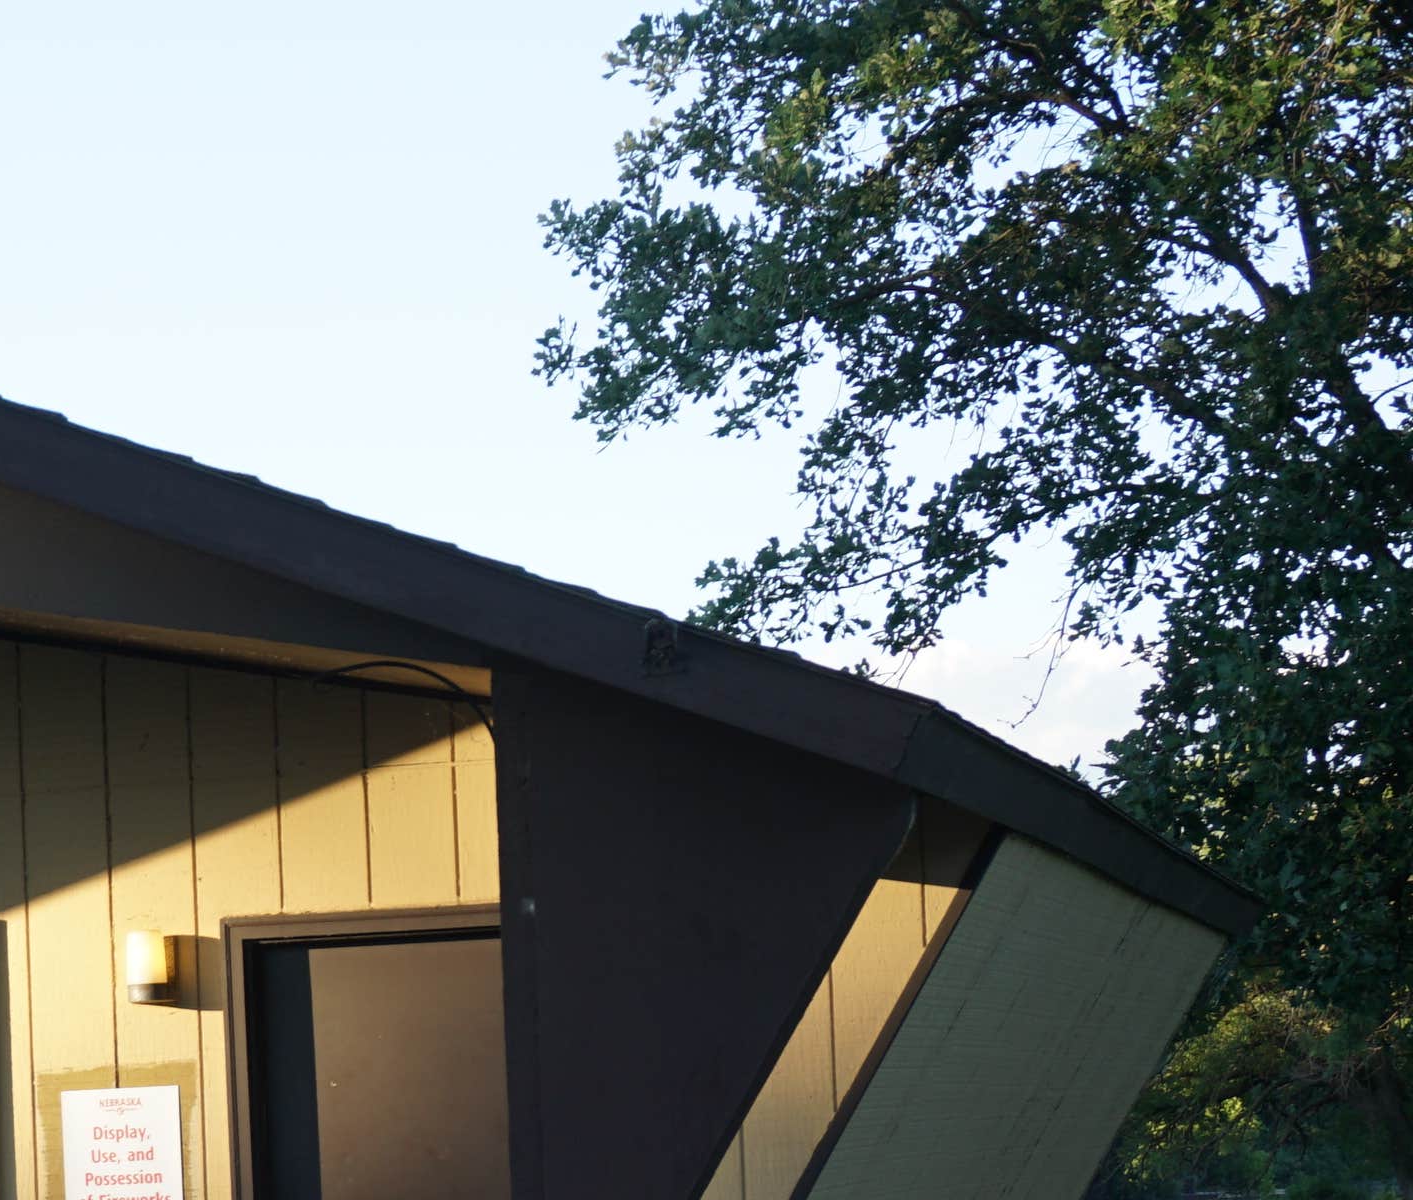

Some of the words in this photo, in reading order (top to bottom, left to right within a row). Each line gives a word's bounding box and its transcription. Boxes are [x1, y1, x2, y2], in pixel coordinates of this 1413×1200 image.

[100, 1098, 142, 1108] NEBRASKA
[92, 1124, 150, 1142] Display,
[91, 1150, 121, 1164] Use,
[127, 1148, 155, 1161] and
[84, 1170, 163, 1186] Possession
